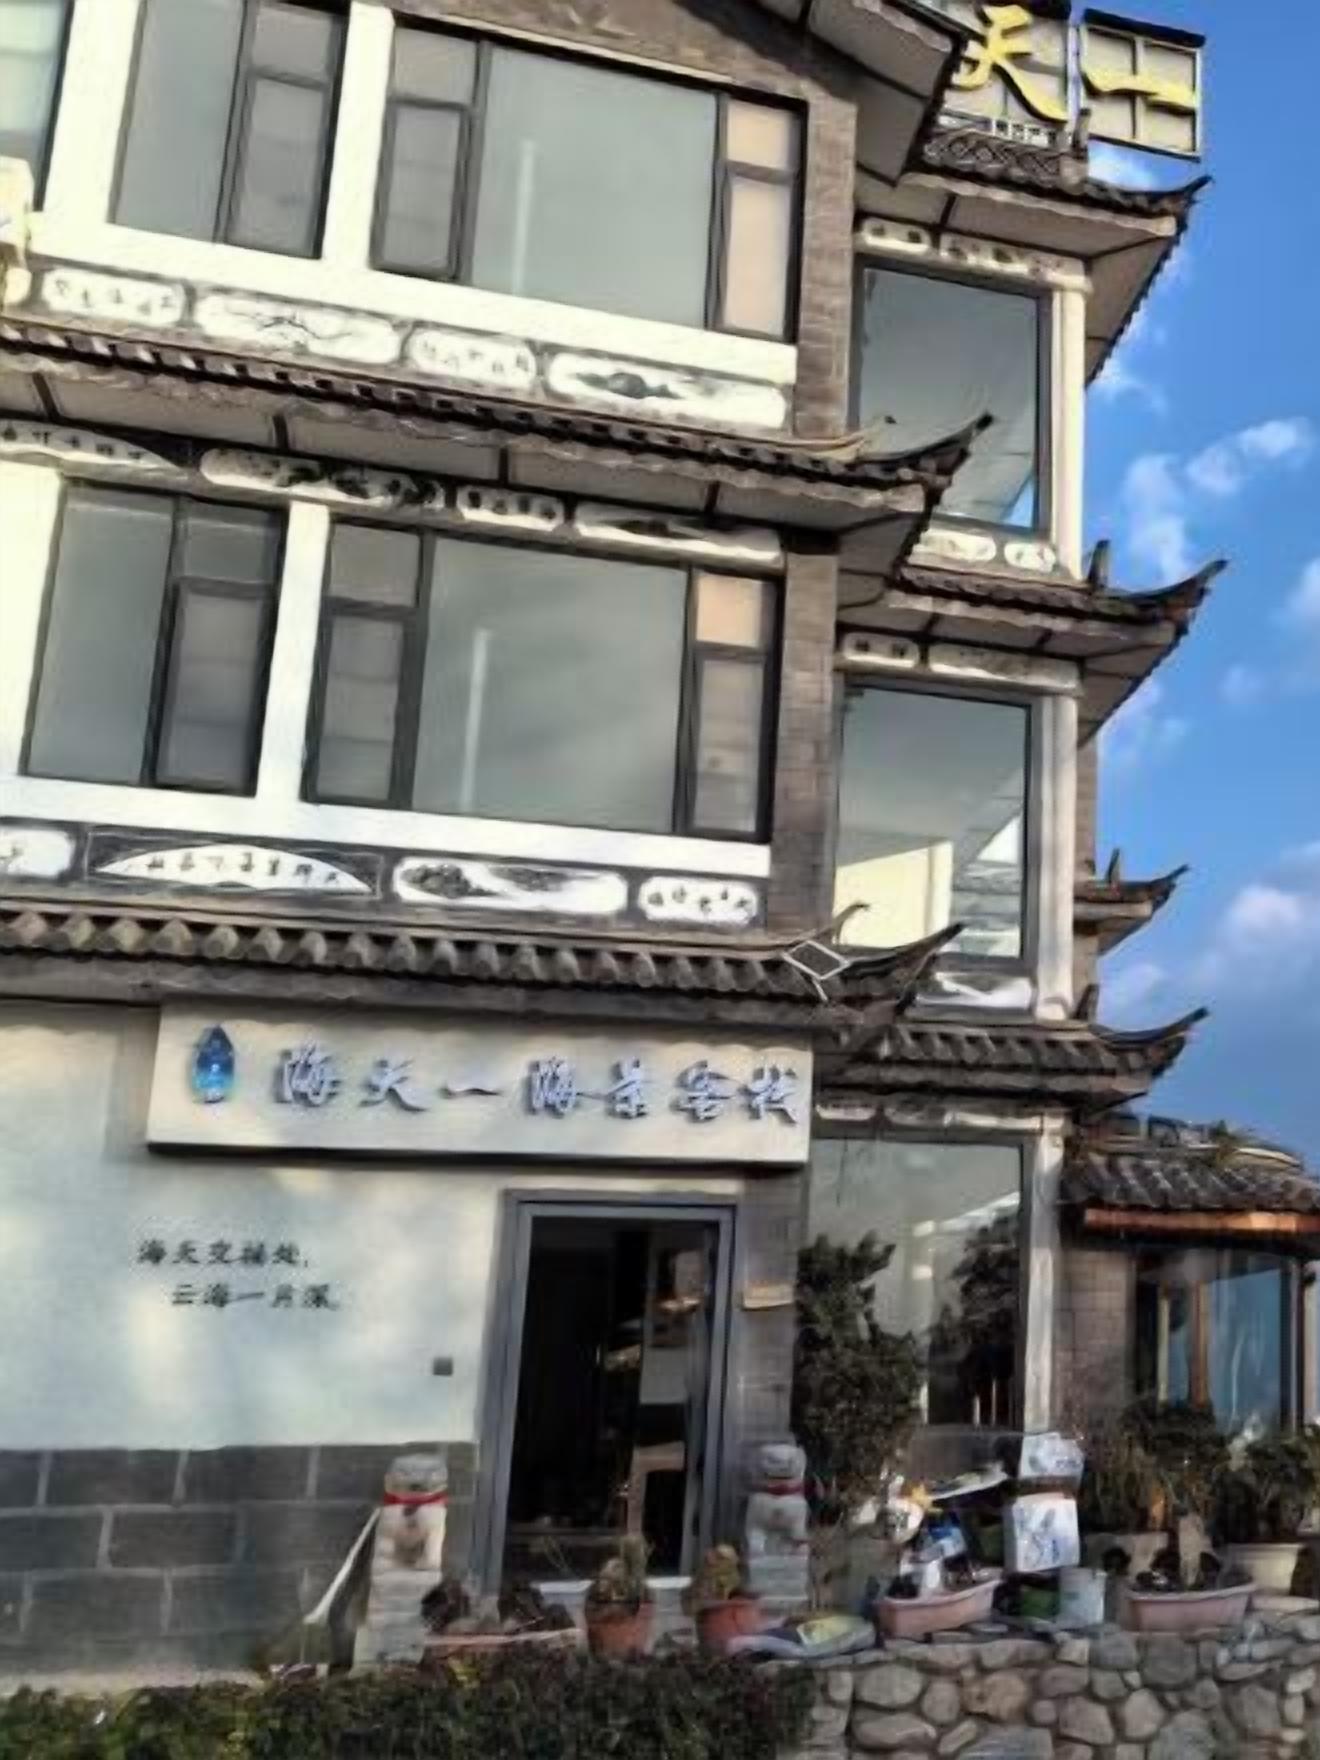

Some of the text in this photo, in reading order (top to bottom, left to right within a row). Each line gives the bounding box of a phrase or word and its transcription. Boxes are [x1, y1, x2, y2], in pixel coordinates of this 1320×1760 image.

[275, 1042, 798, 1126] 海天一海景客栈
